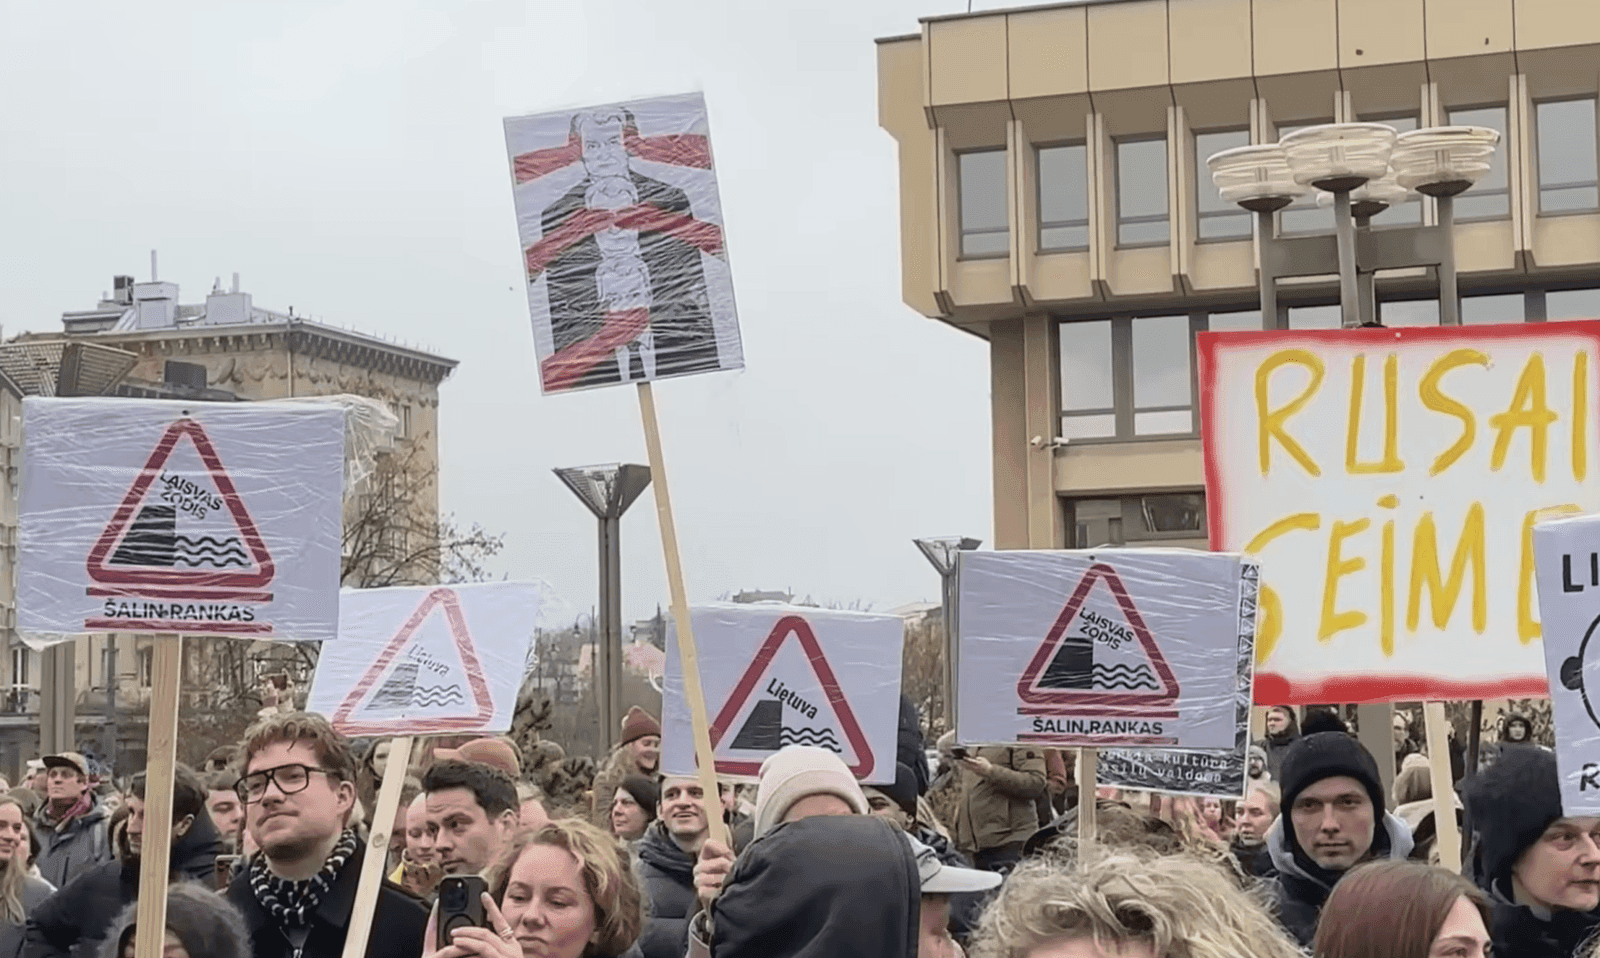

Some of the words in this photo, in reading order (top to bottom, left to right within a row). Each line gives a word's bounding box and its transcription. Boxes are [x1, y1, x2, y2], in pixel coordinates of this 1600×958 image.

[1253, 347, 1588, 484] RUSAI
[159, 468, 223, 511] LAISVAS
[160, 484, 208, 520] ŽODIS
[1079, 606, 1135, 642] LAISVAS
[1079, 620, 1121, 650] ŽODIS
[407, 643, 450, 677] Lietuva
[766, 677, 818, 719] Lietuva
